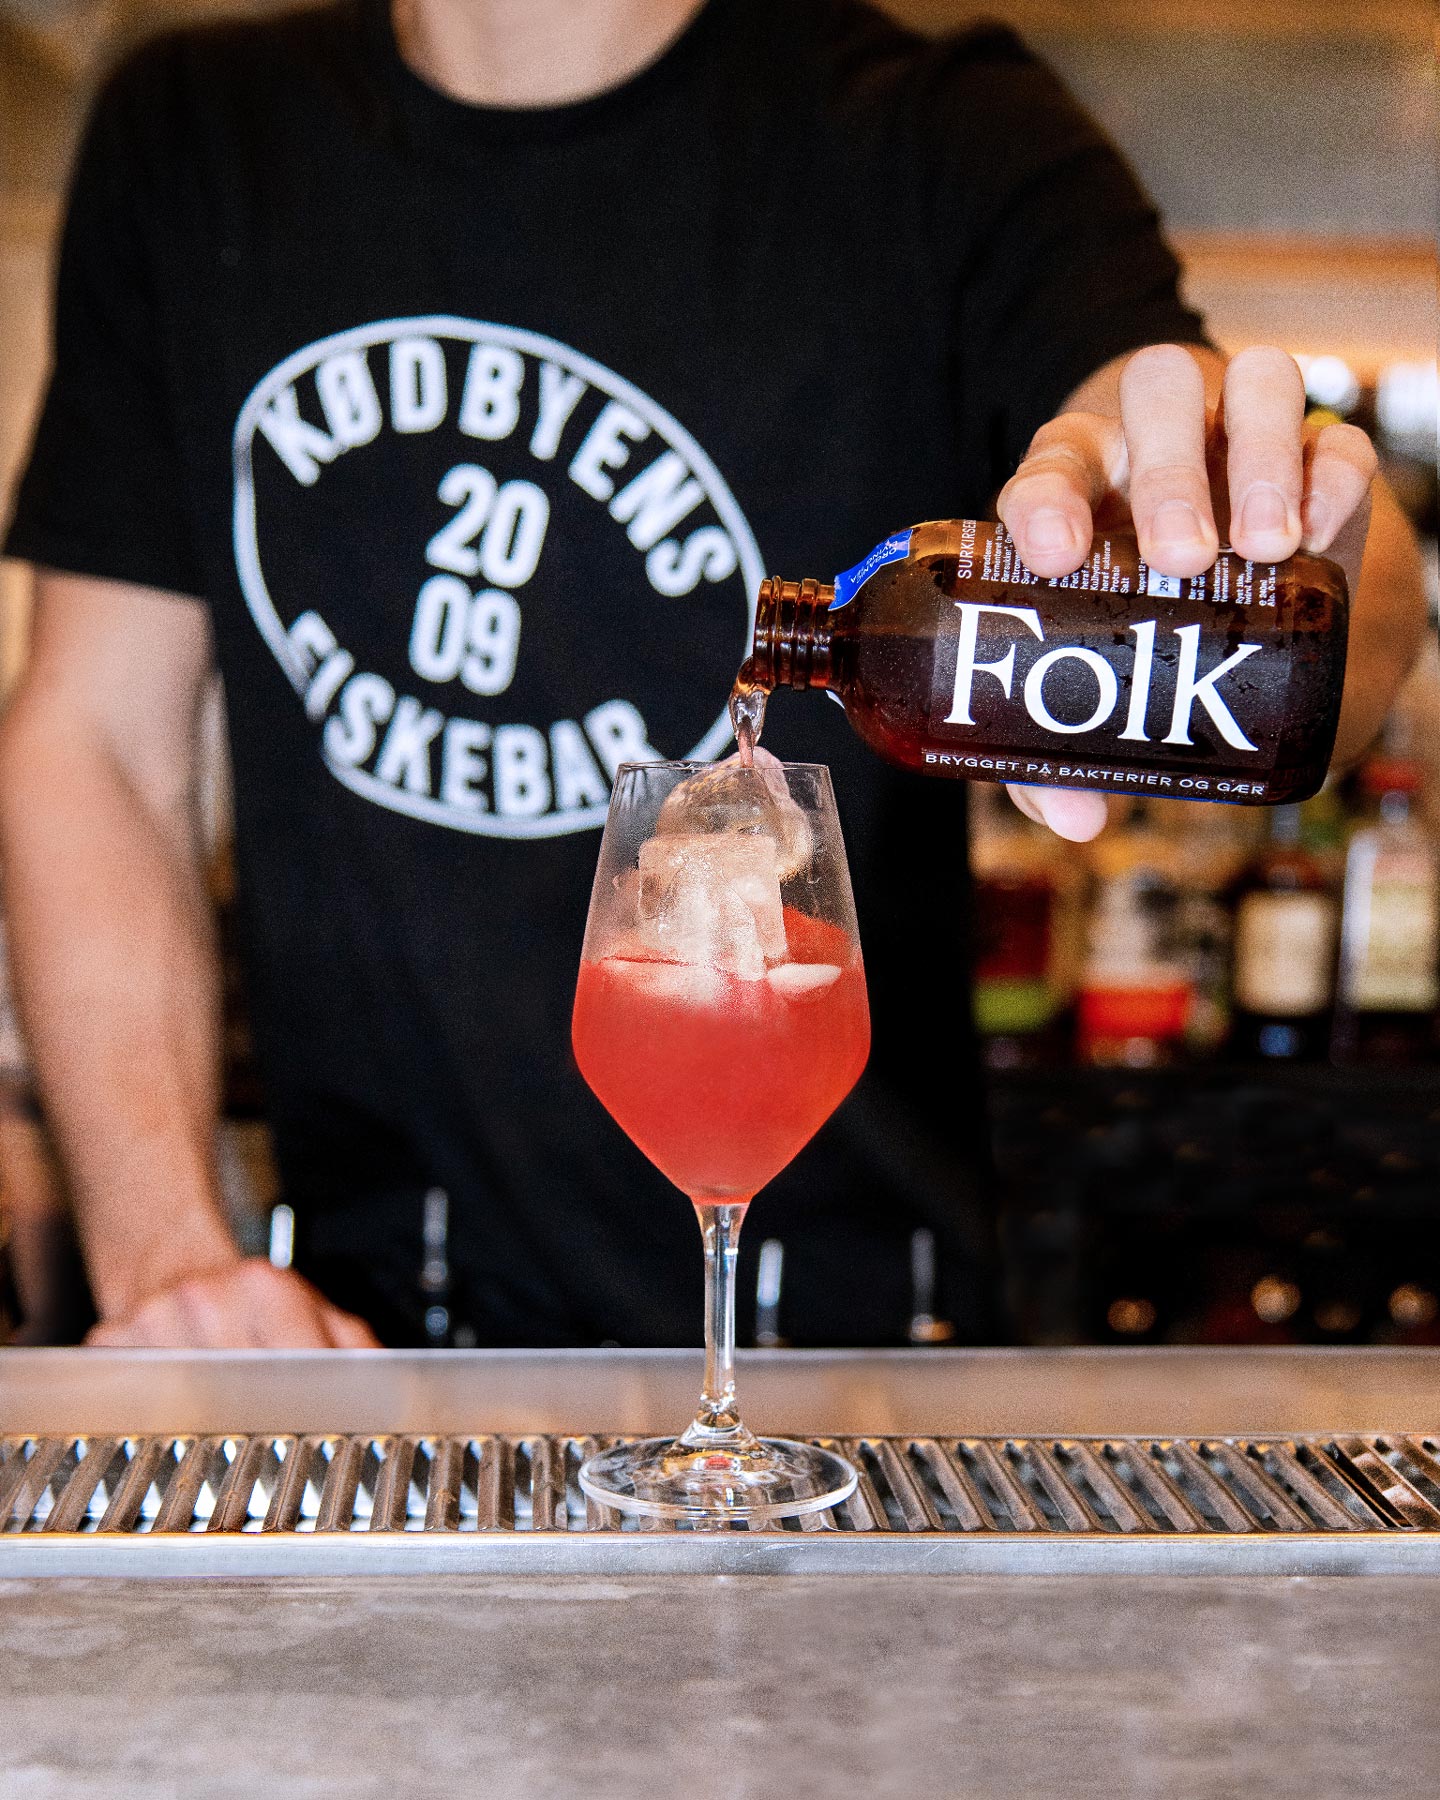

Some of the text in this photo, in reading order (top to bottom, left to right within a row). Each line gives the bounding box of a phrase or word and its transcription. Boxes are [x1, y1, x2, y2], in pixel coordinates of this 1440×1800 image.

[257, 337, 739, 597] KØDBYENS
[426, 463, 550, 589] 20
[1080, 569, 1089, 590] heraf
[1100, 571, 1109, 592] heraf
[1110, 566, 1120, 593] Protein
[1120, 577, 1130, 594] Salt
[408, 574, 522, 697] 09
[943, 602, 1263, 751] Folk
[286, 608, 668, 819] FISKEBAR
[925, 753, 1264, 796] BRYGGET PÅ BAKTERIER OG GÆR
